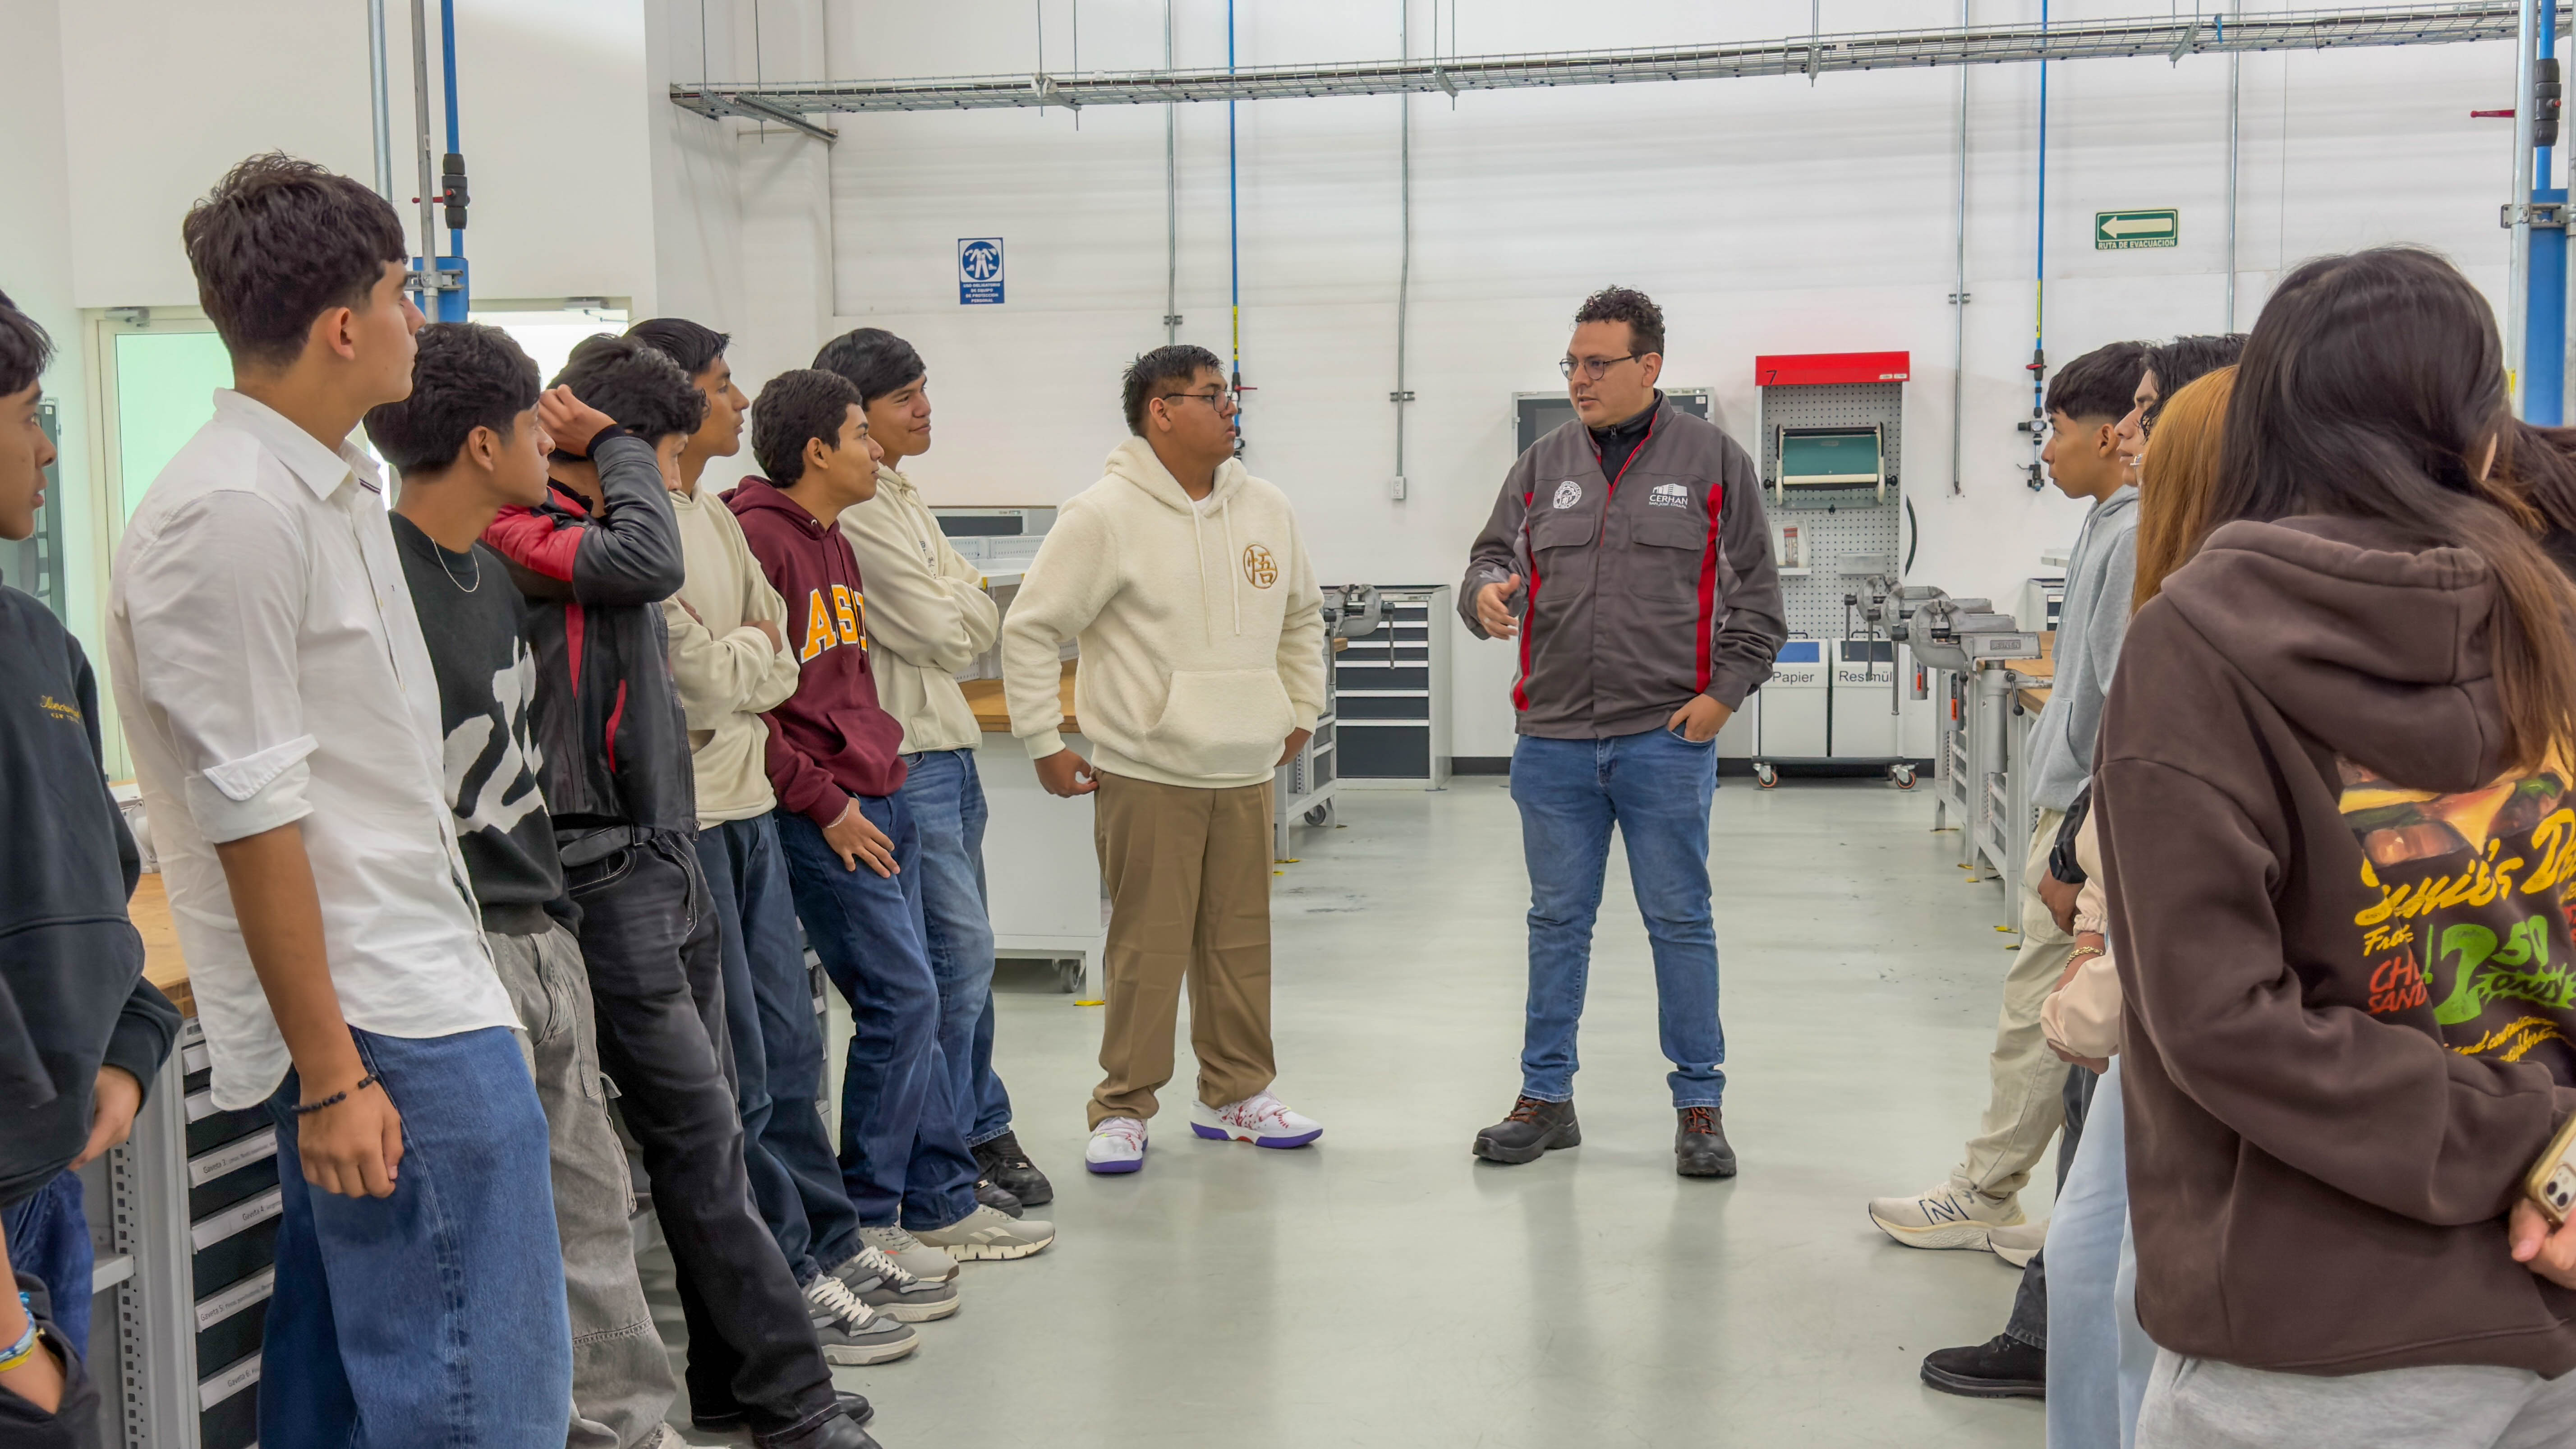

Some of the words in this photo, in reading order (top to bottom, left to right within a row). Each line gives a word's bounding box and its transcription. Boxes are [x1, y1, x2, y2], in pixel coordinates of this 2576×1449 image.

[1766, 370, 1777, 386] 7
[1649, 495, 1688, 506] CERHAN
[1773, 671, 1814, 685] Papier
[1840, 671, 1892, 682] Restmül
[201, 1309, 219, 1321] Gaveta
